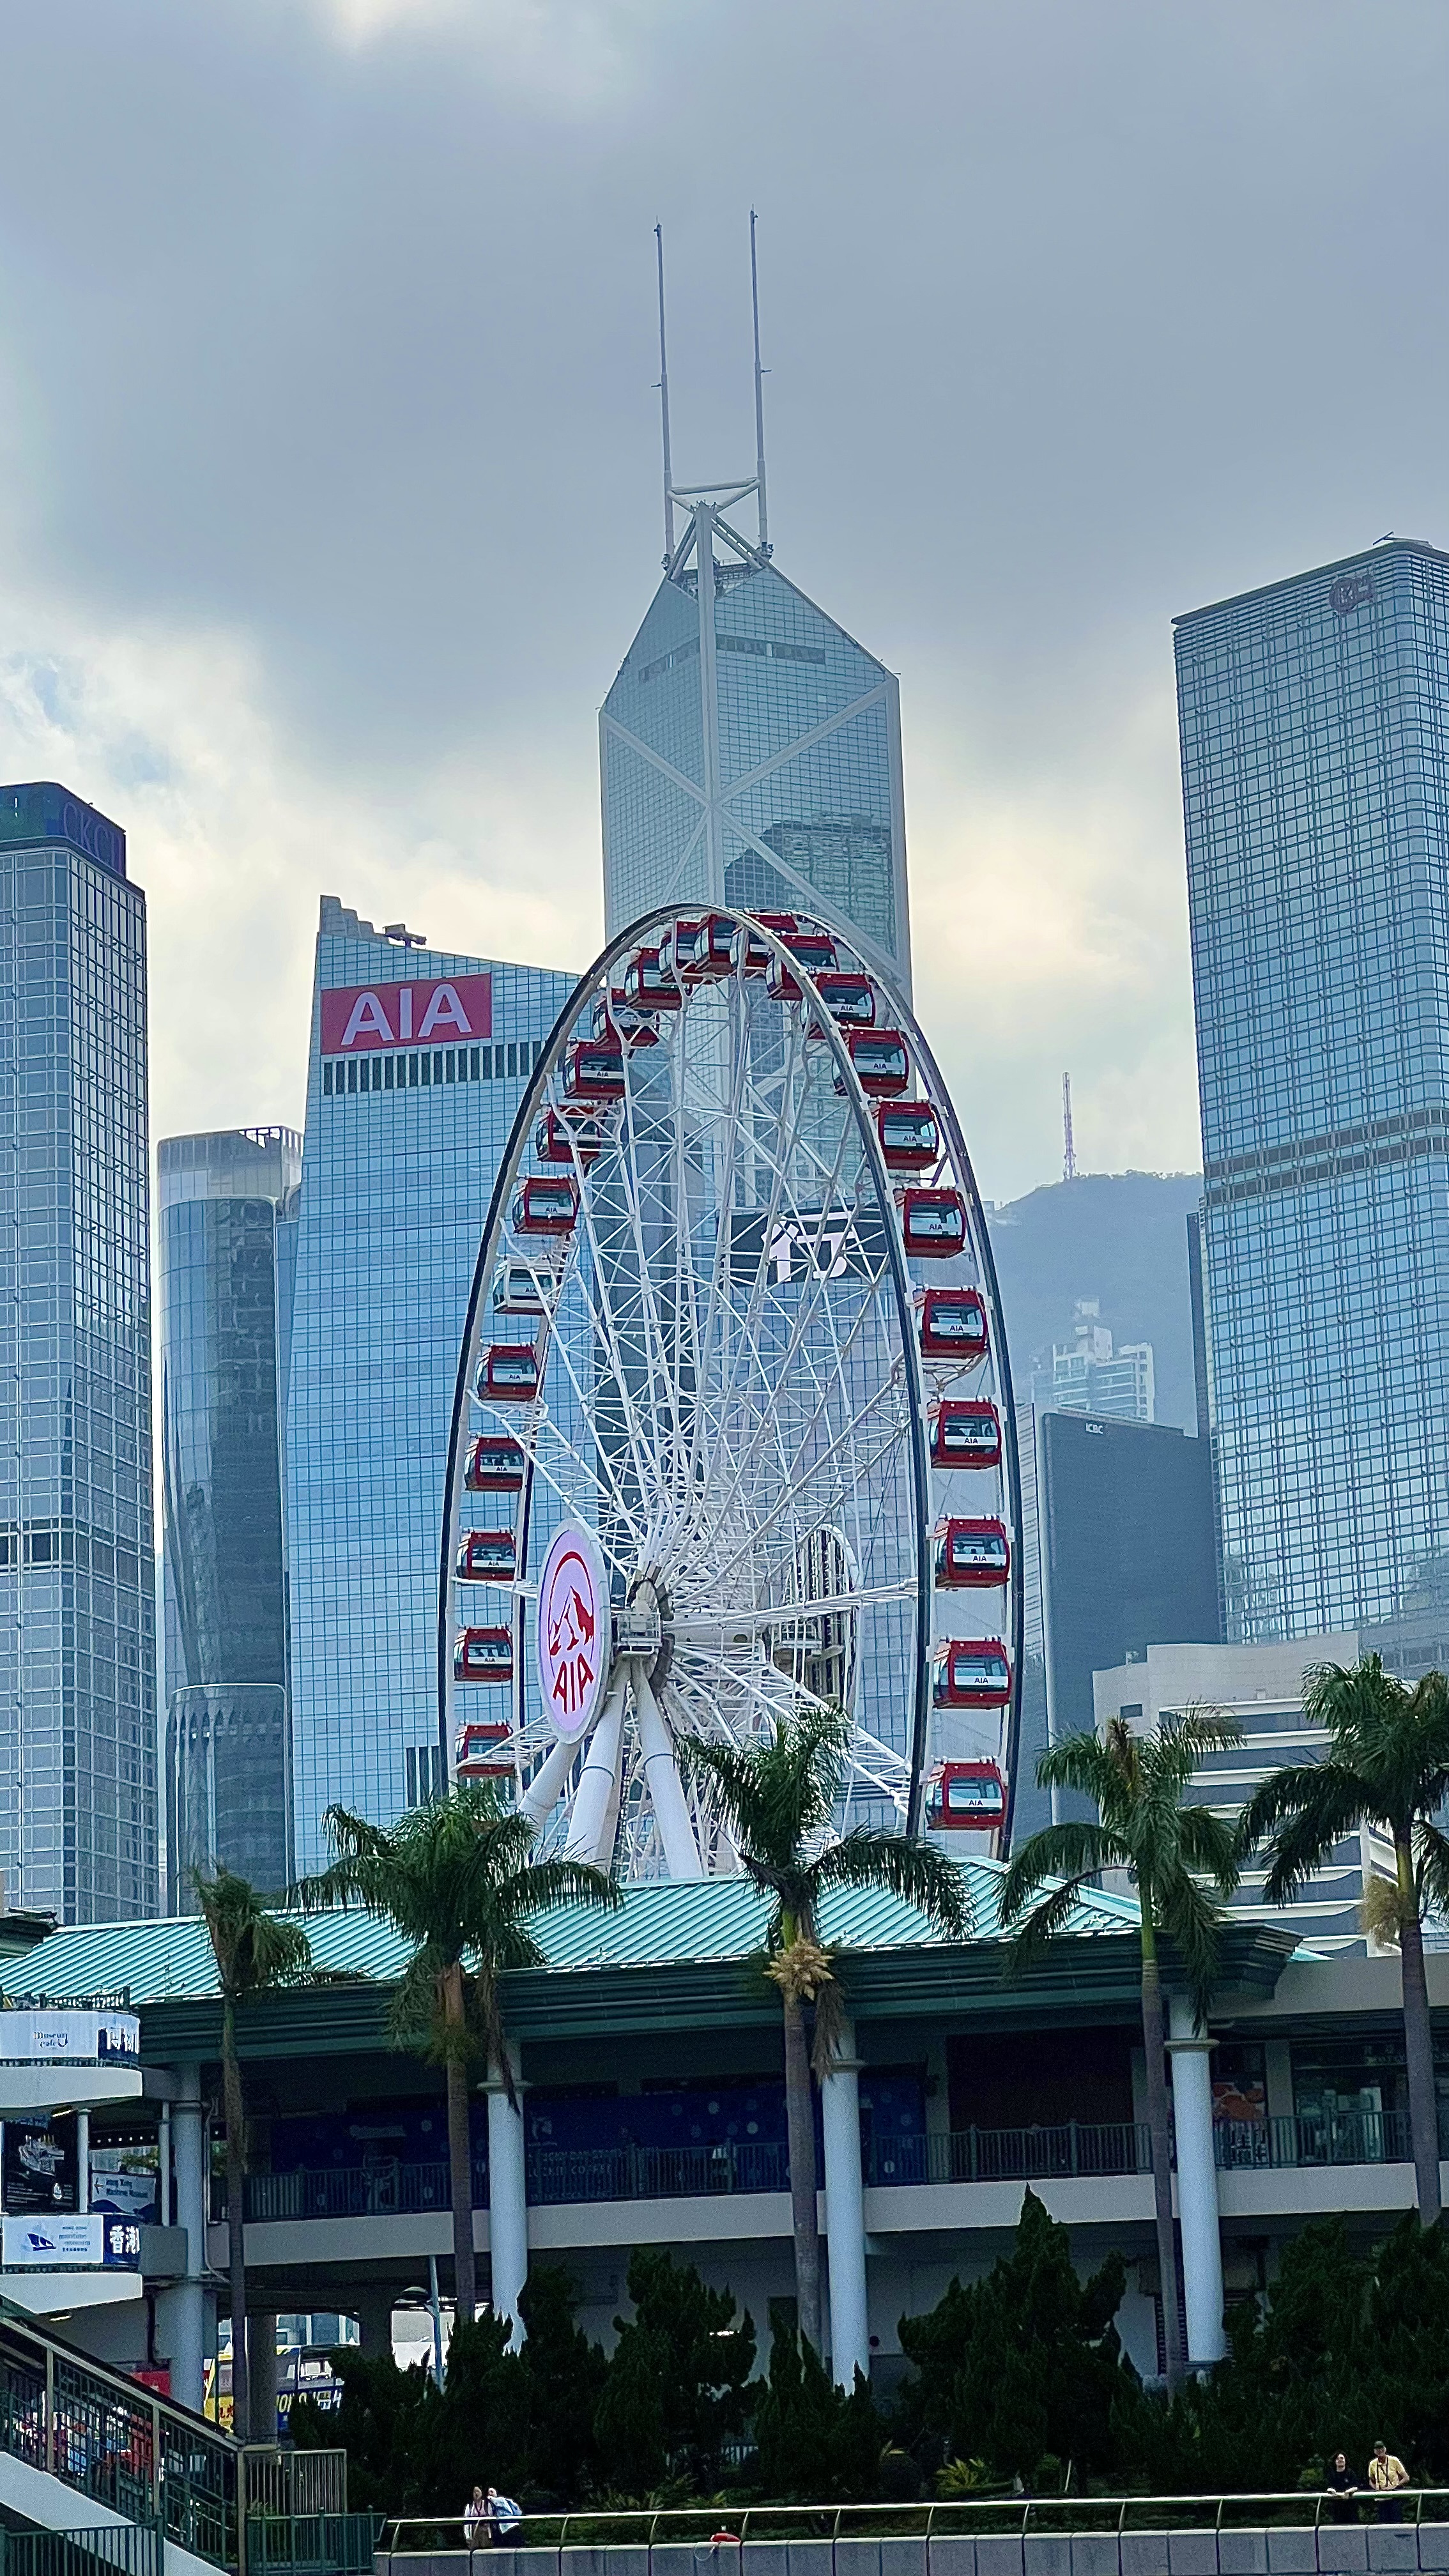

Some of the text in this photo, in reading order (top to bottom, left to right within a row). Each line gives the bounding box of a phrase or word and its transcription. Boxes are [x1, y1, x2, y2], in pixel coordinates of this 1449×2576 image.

[341, 983, 472, 1046] AIA
[761, 1211, 856, 1282] 行
[552, 1652, 594, 1714] AIA
